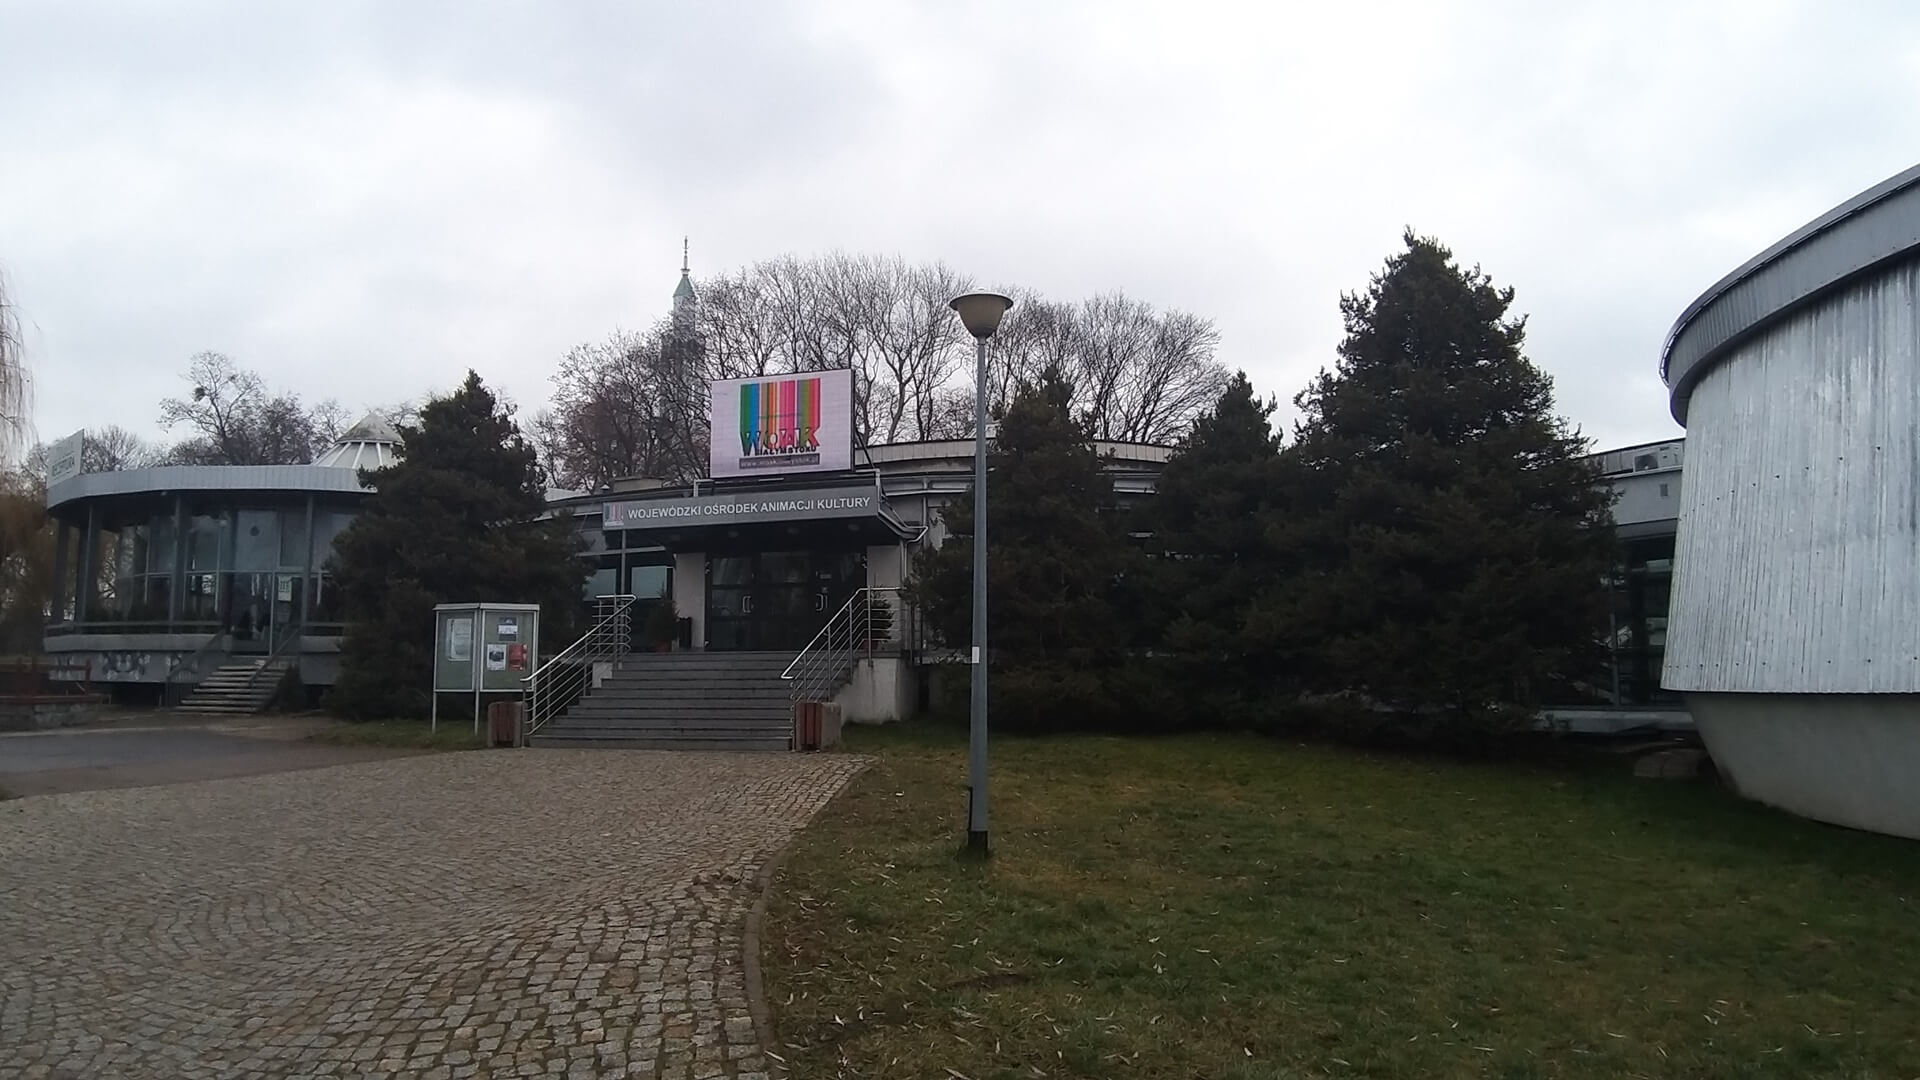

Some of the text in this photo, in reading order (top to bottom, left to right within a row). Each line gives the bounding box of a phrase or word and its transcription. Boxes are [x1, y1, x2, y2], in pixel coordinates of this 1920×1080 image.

[628, 497, 870, 519] WOJEWÓDZKI OŚRODEK ANIMACJI KULTURY
